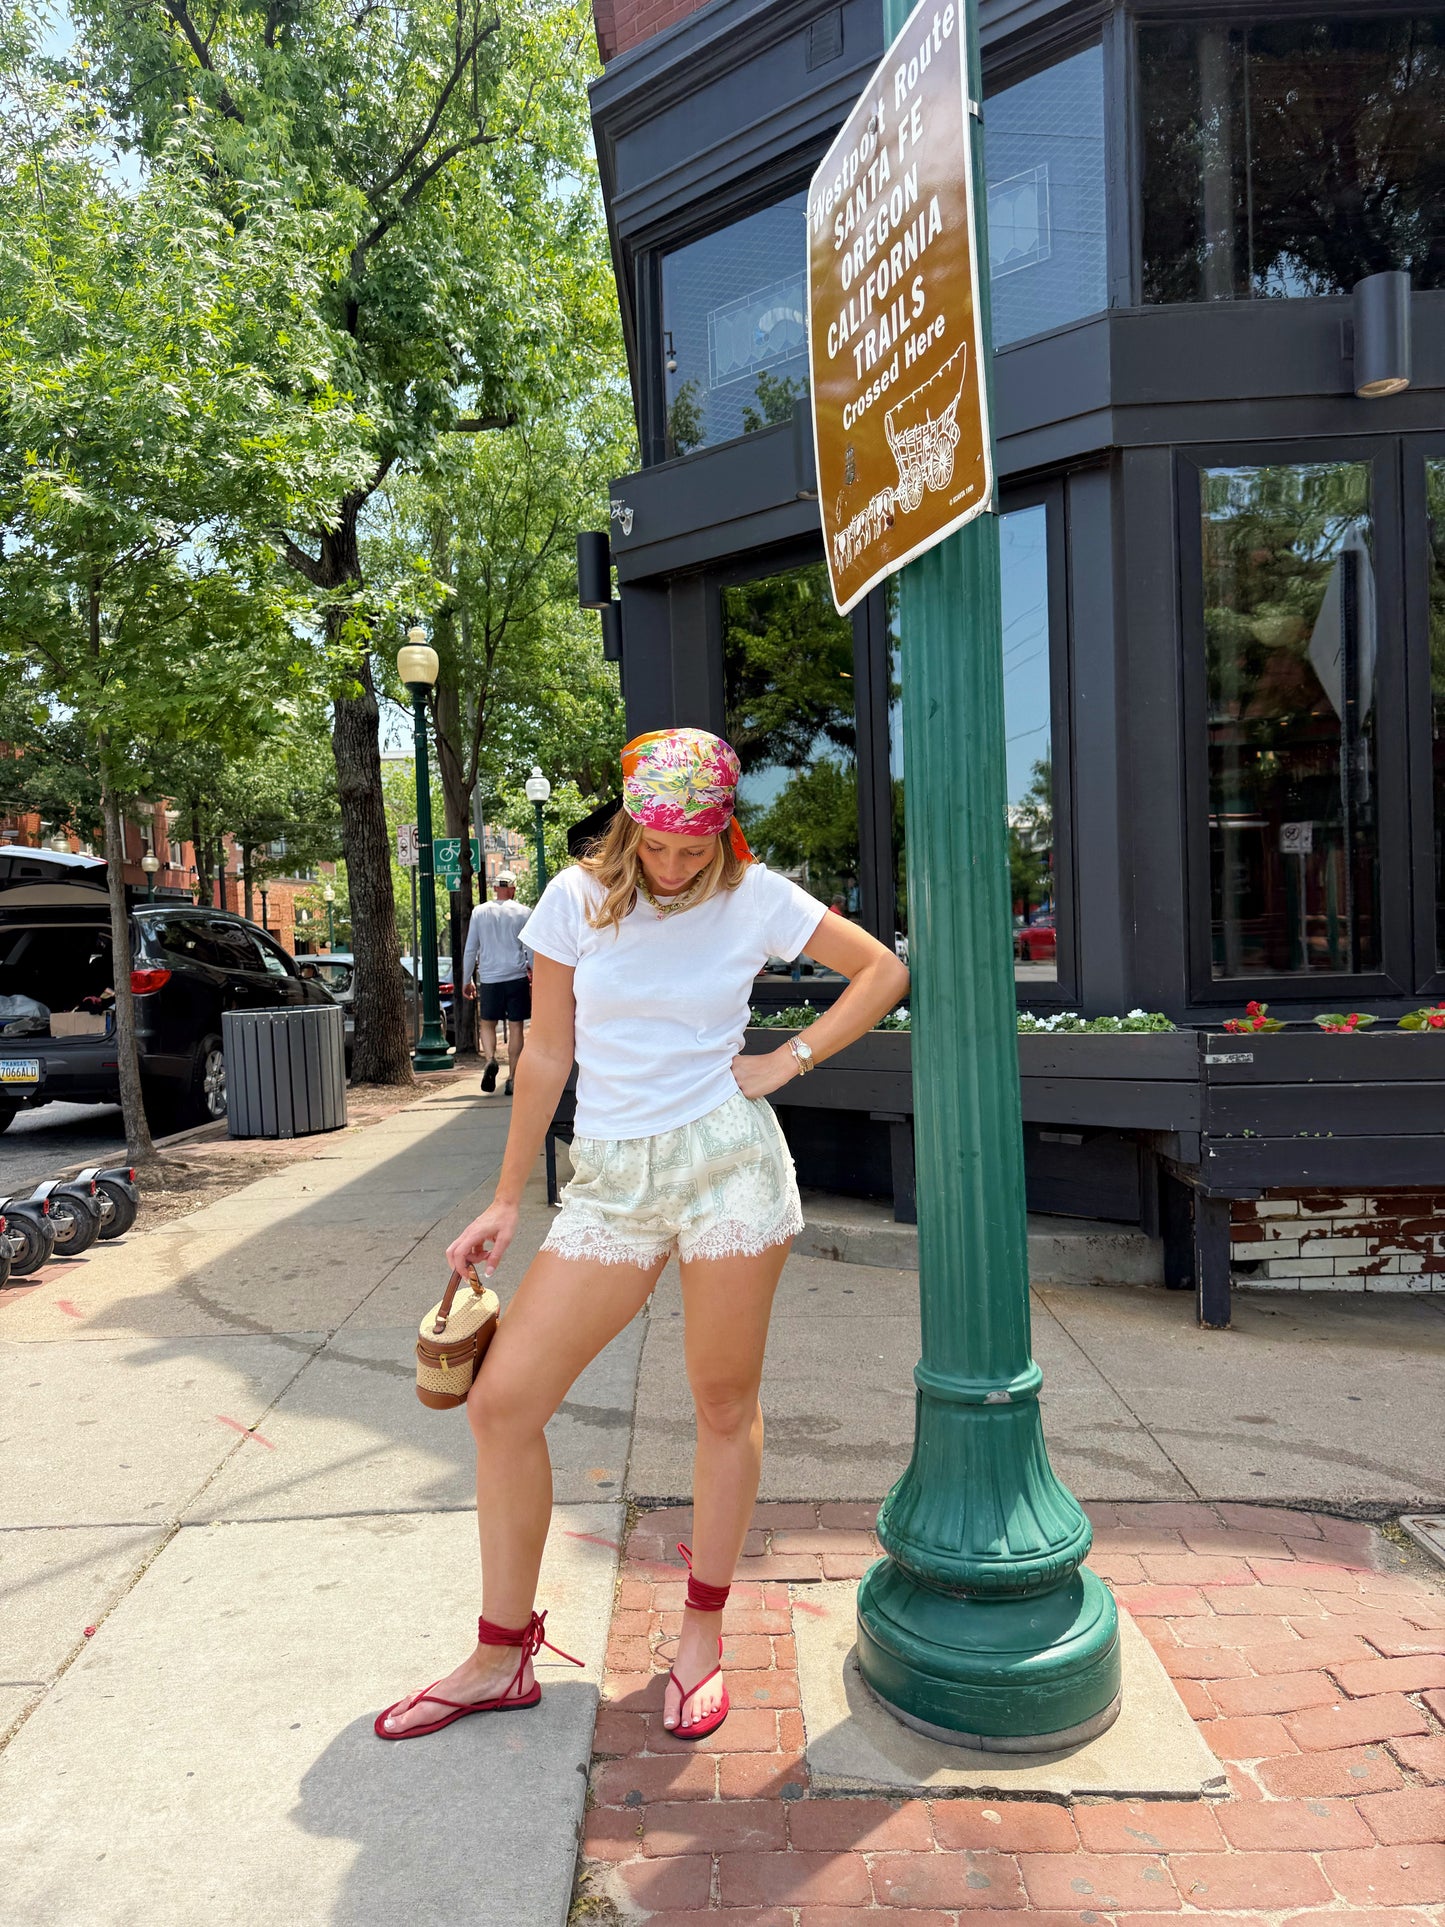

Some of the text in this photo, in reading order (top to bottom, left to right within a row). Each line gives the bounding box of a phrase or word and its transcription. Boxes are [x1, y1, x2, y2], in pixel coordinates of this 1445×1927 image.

[894, 3, 955, 111] Route
[834, 95, 924, 251] SANTA FE
[841, 162, 918, 291] OREGON
[827, 195, 943, 360] CALIFORNIA
[853, 274, 925, 381] TRAILS
[842, 314, 945, 431] Crossed Here
[436, 864, 451, 872] BIKE
